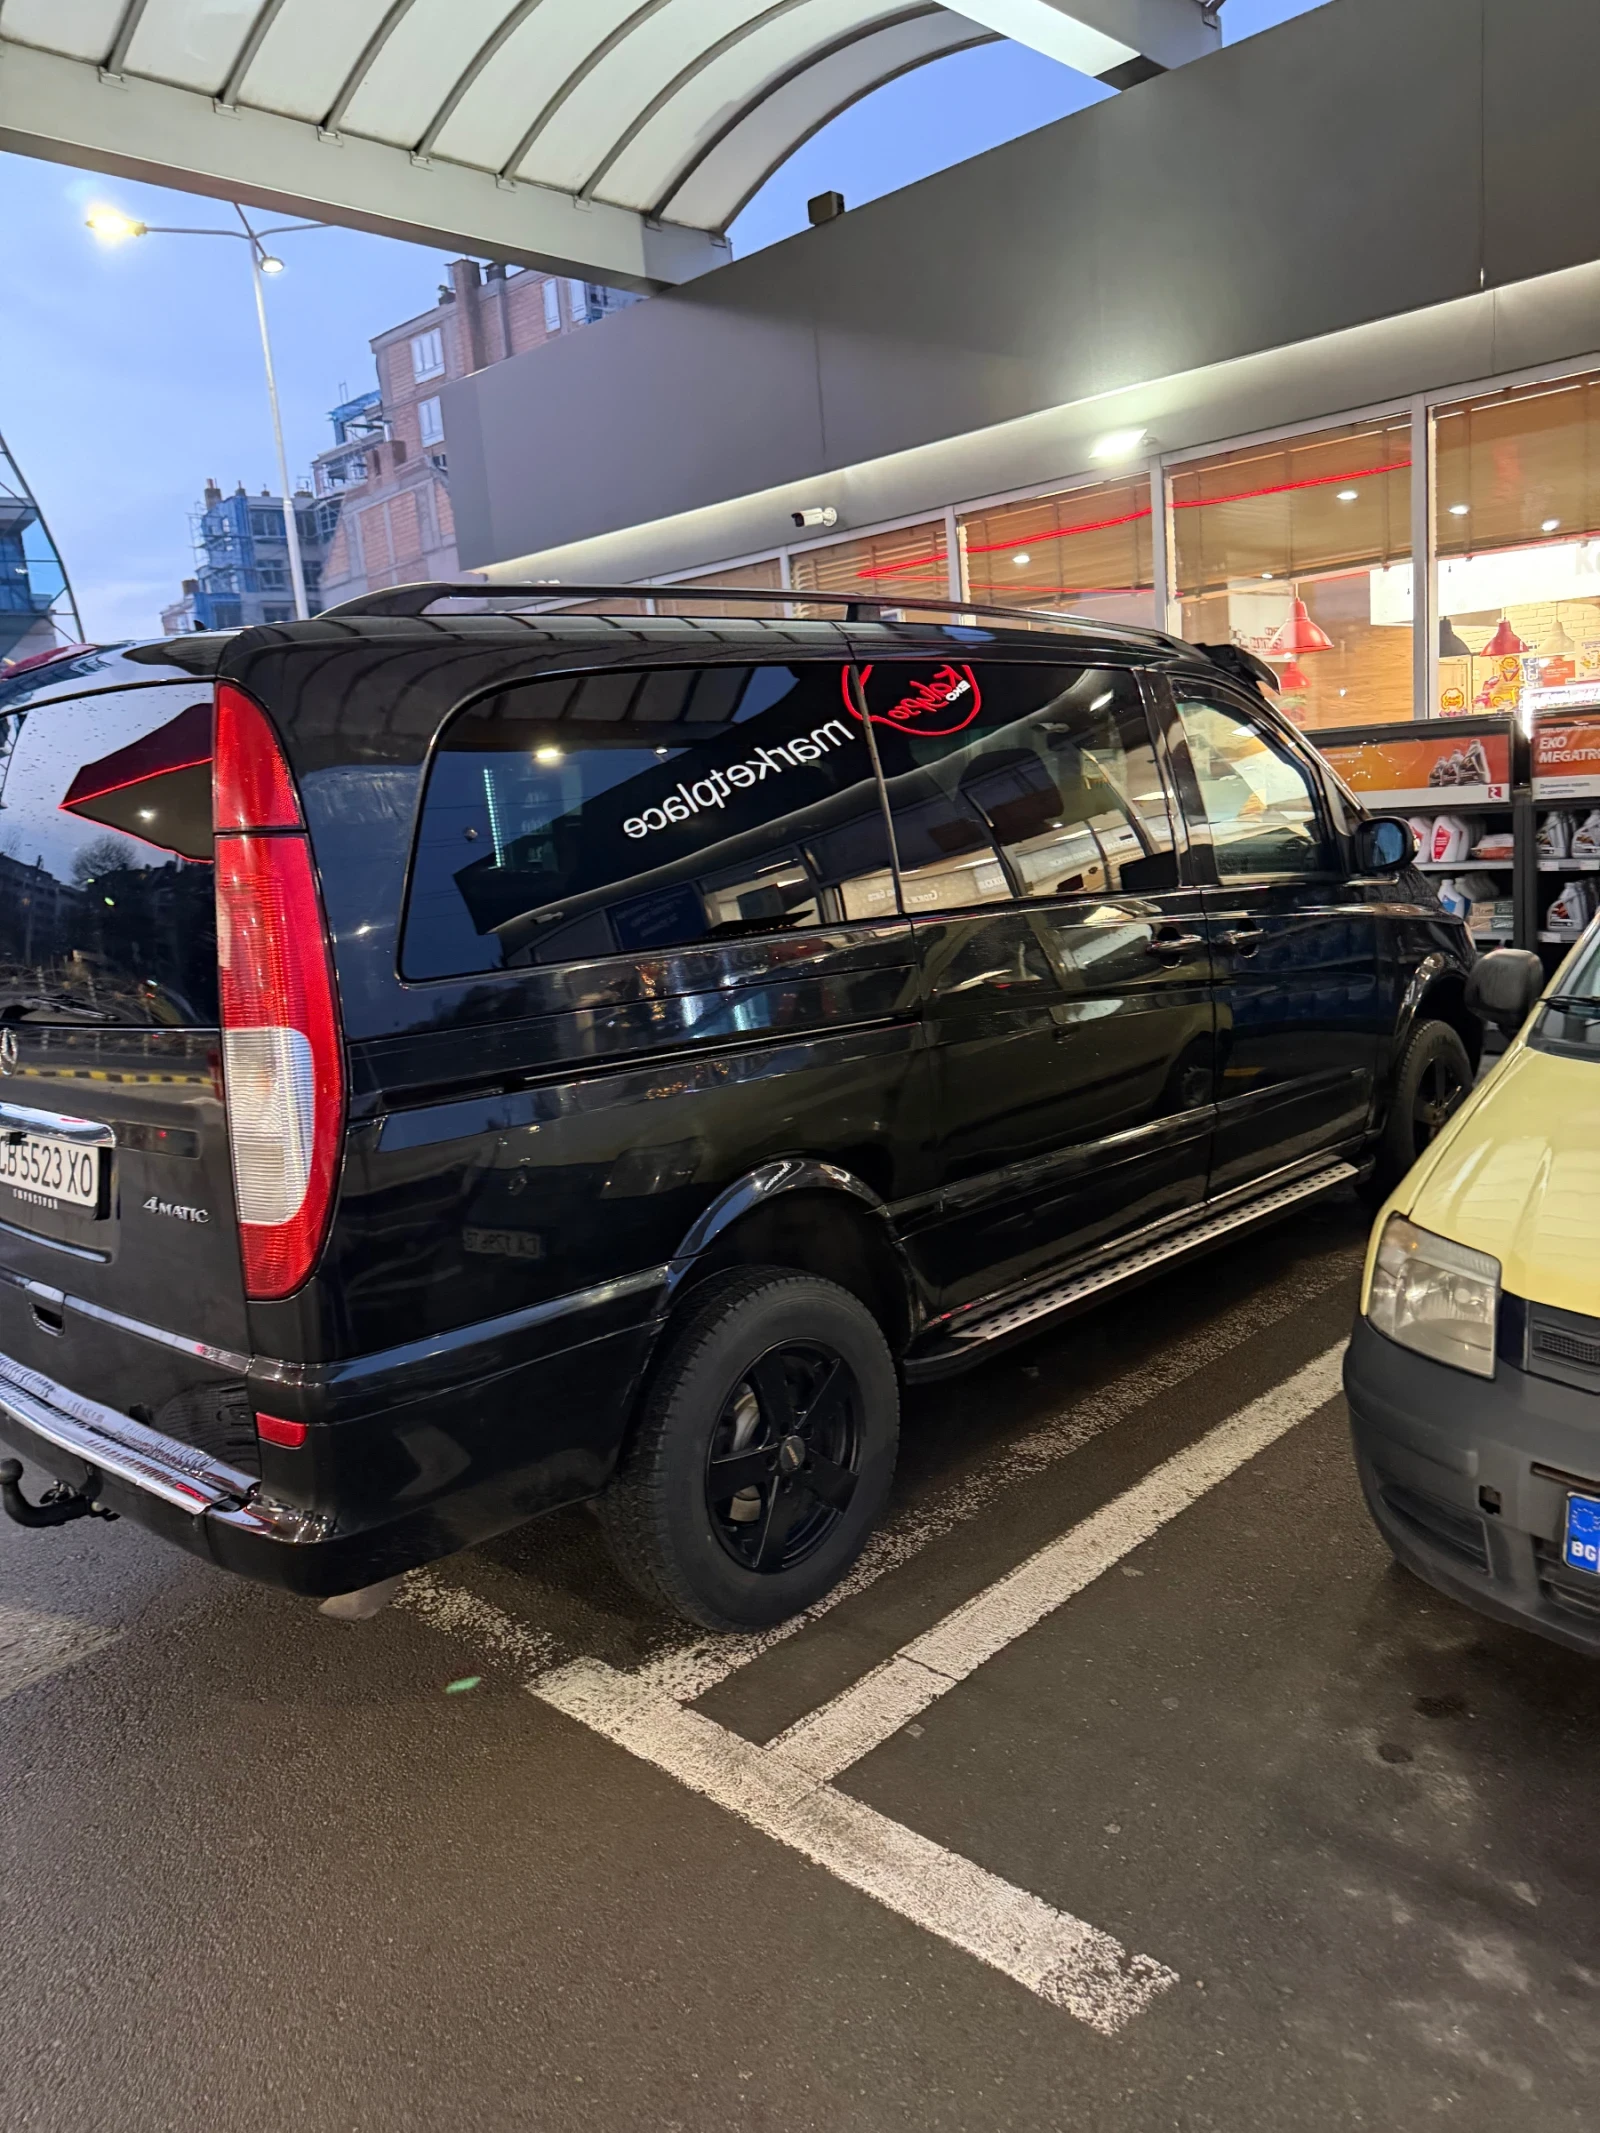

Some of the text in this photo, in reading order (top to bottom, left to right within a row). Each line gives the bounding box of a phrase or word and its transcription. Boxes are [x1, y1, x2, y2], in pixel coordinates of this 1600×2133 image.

[1538, 736, 1567, 750] EKO
[20, 1140, 62, 1190] 5523
[143, 1196, 209, 1223] 4MATIC
[1571, 1541, 1597, 1561] BG
